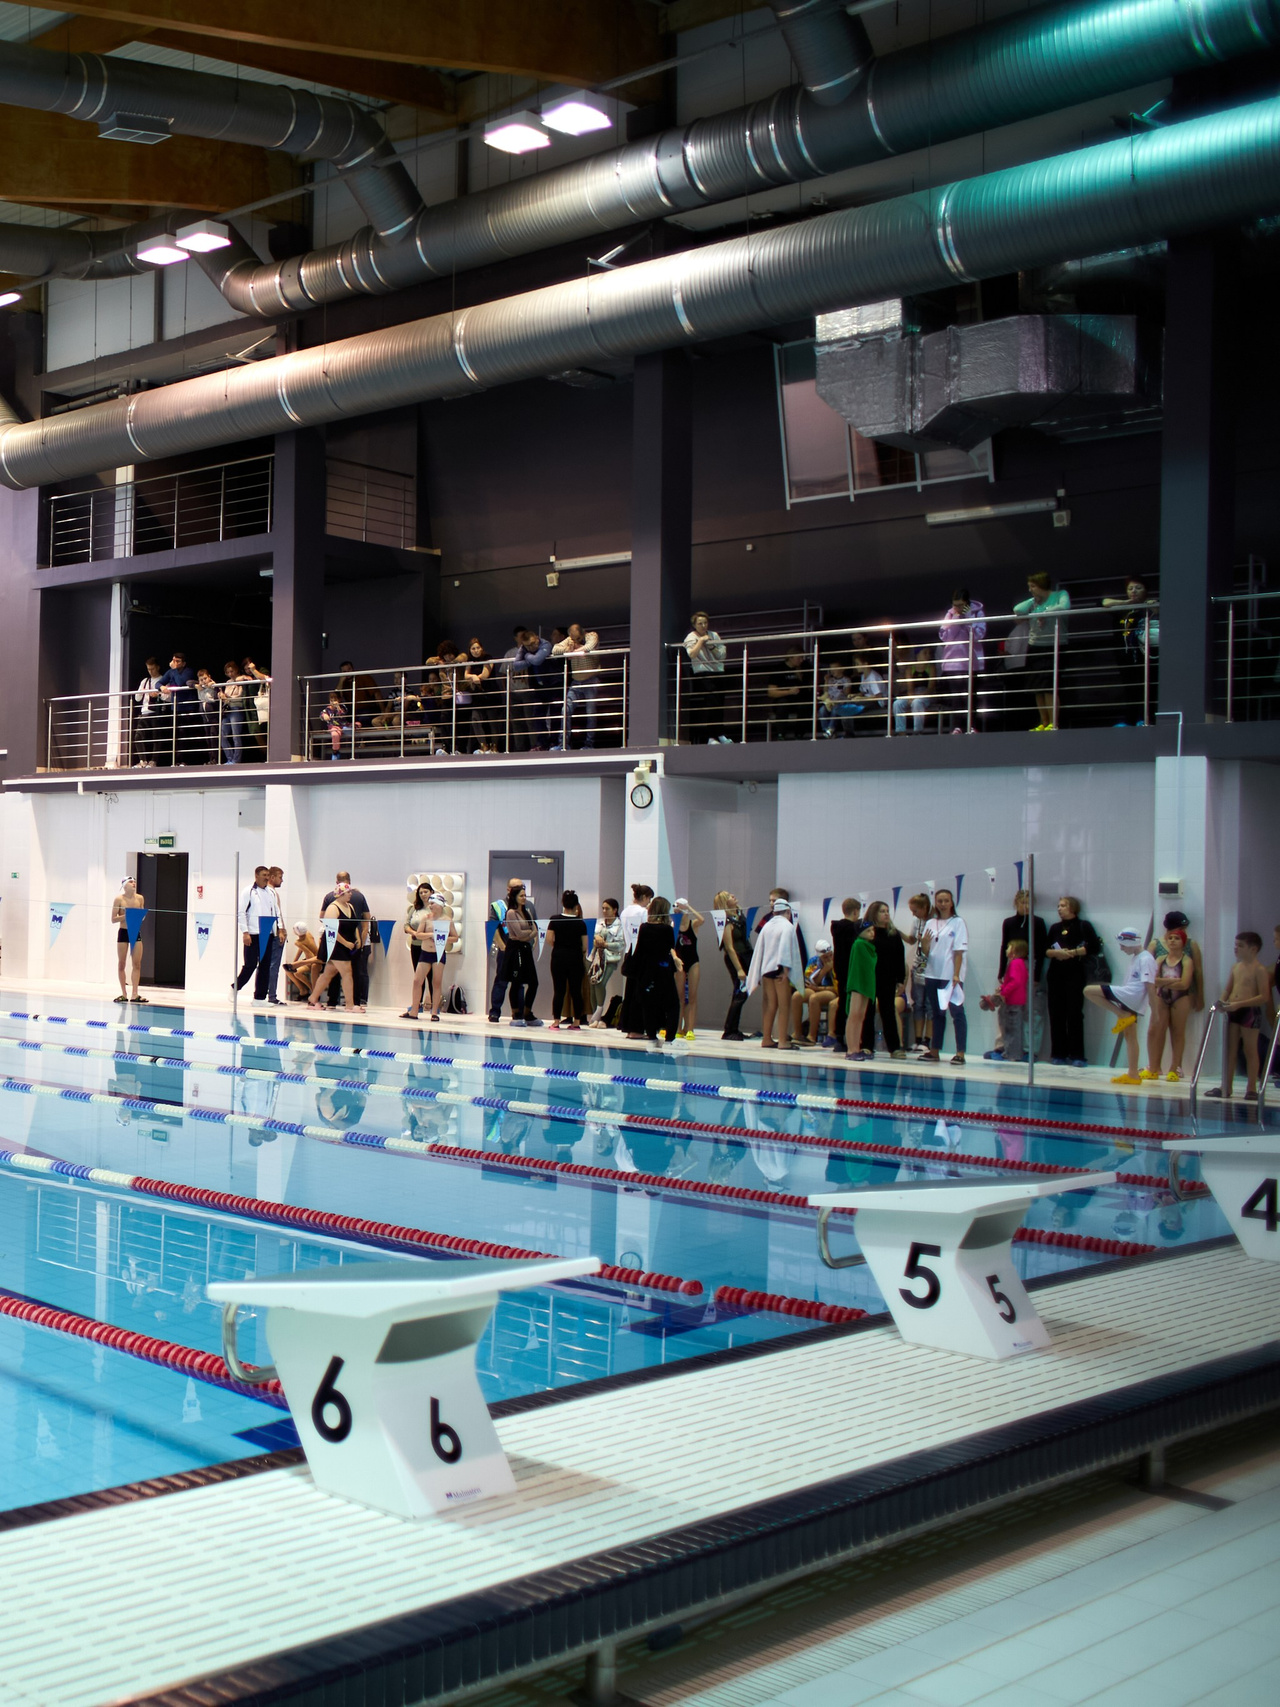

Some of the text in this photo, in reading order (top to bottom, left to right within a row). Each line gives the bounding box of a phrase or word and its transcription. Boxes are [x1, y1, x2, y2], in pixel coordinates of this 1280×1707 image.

[1241, 1178, 1280, 1232] 4
[898, 1242, 941, 1309] 5
[986, 1274, 1016, 1324] 5
[311, 1355, 352, 1443] 6
[430, 1396, 462, 1464] 6
